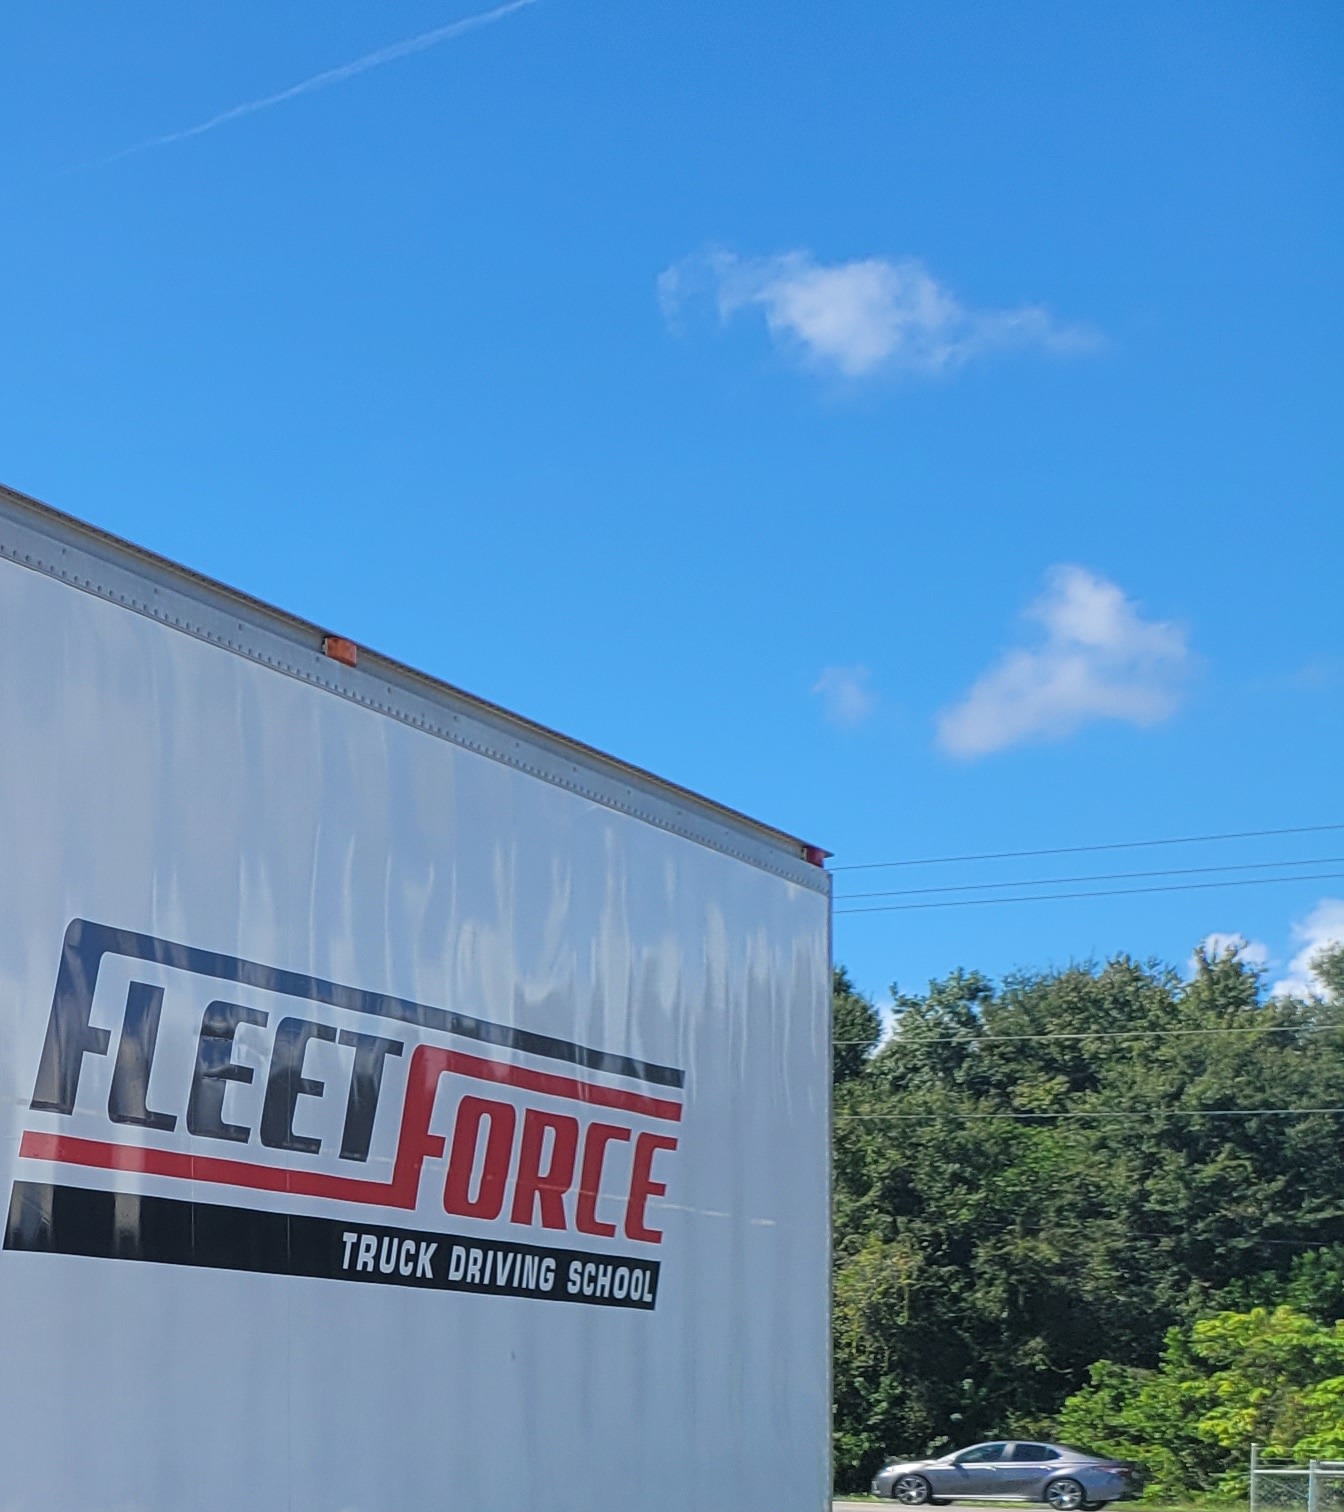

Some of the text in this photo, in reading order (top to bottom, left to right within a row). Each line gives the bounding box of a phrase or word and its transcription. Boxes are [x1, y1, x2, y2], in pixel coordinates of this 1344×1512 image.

[343, 1231, 654, 1303] TRUCK DRIVING SCHOOL
